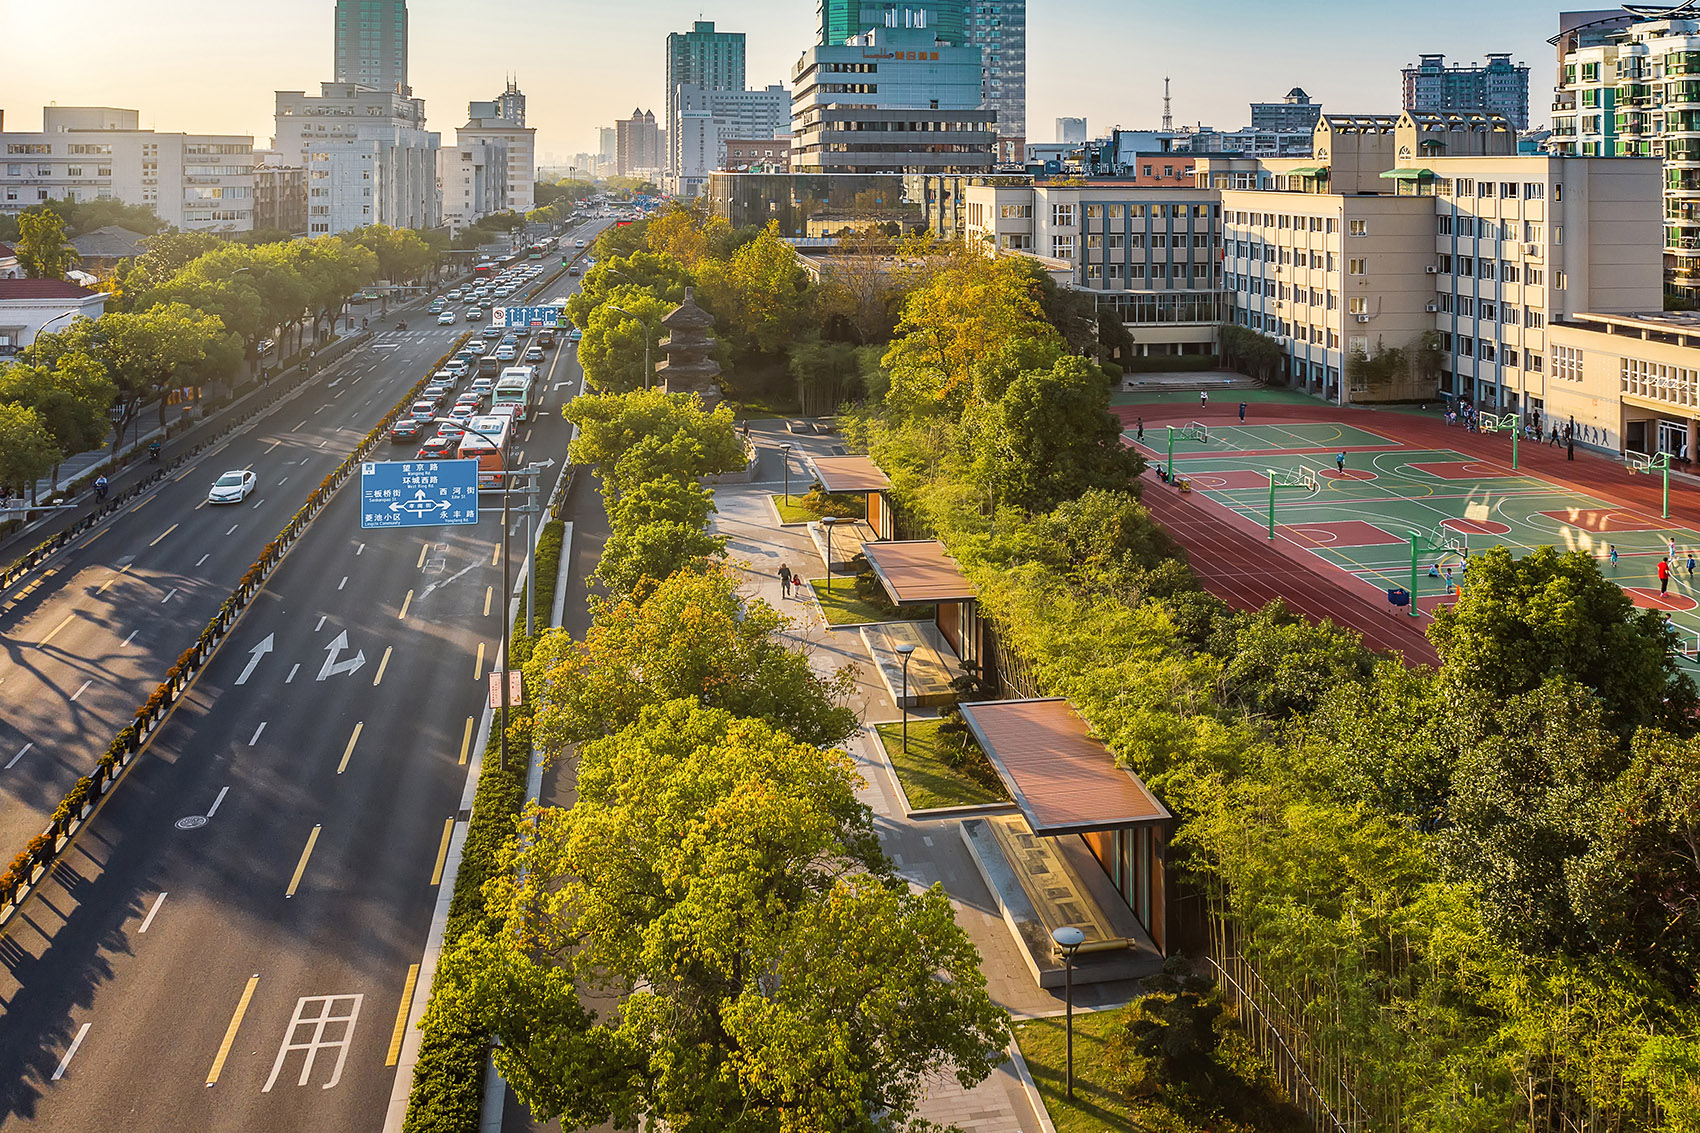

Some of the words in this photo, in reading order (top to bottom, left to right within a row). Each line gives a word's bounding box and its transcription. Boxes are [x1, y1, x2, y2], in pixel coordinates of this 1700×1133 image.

[402, 463, 439, 472] 望京路
[402, 476, 439, 484] 环城西路
[365, 489, 401, 498] 三板桥街
[439, 486, 475, 496] 西河街
[365, 513, 401, 522] 菱池小区
[439, 510, 475, 519] 永丰路
[261, 994, 364, 1093] 用
